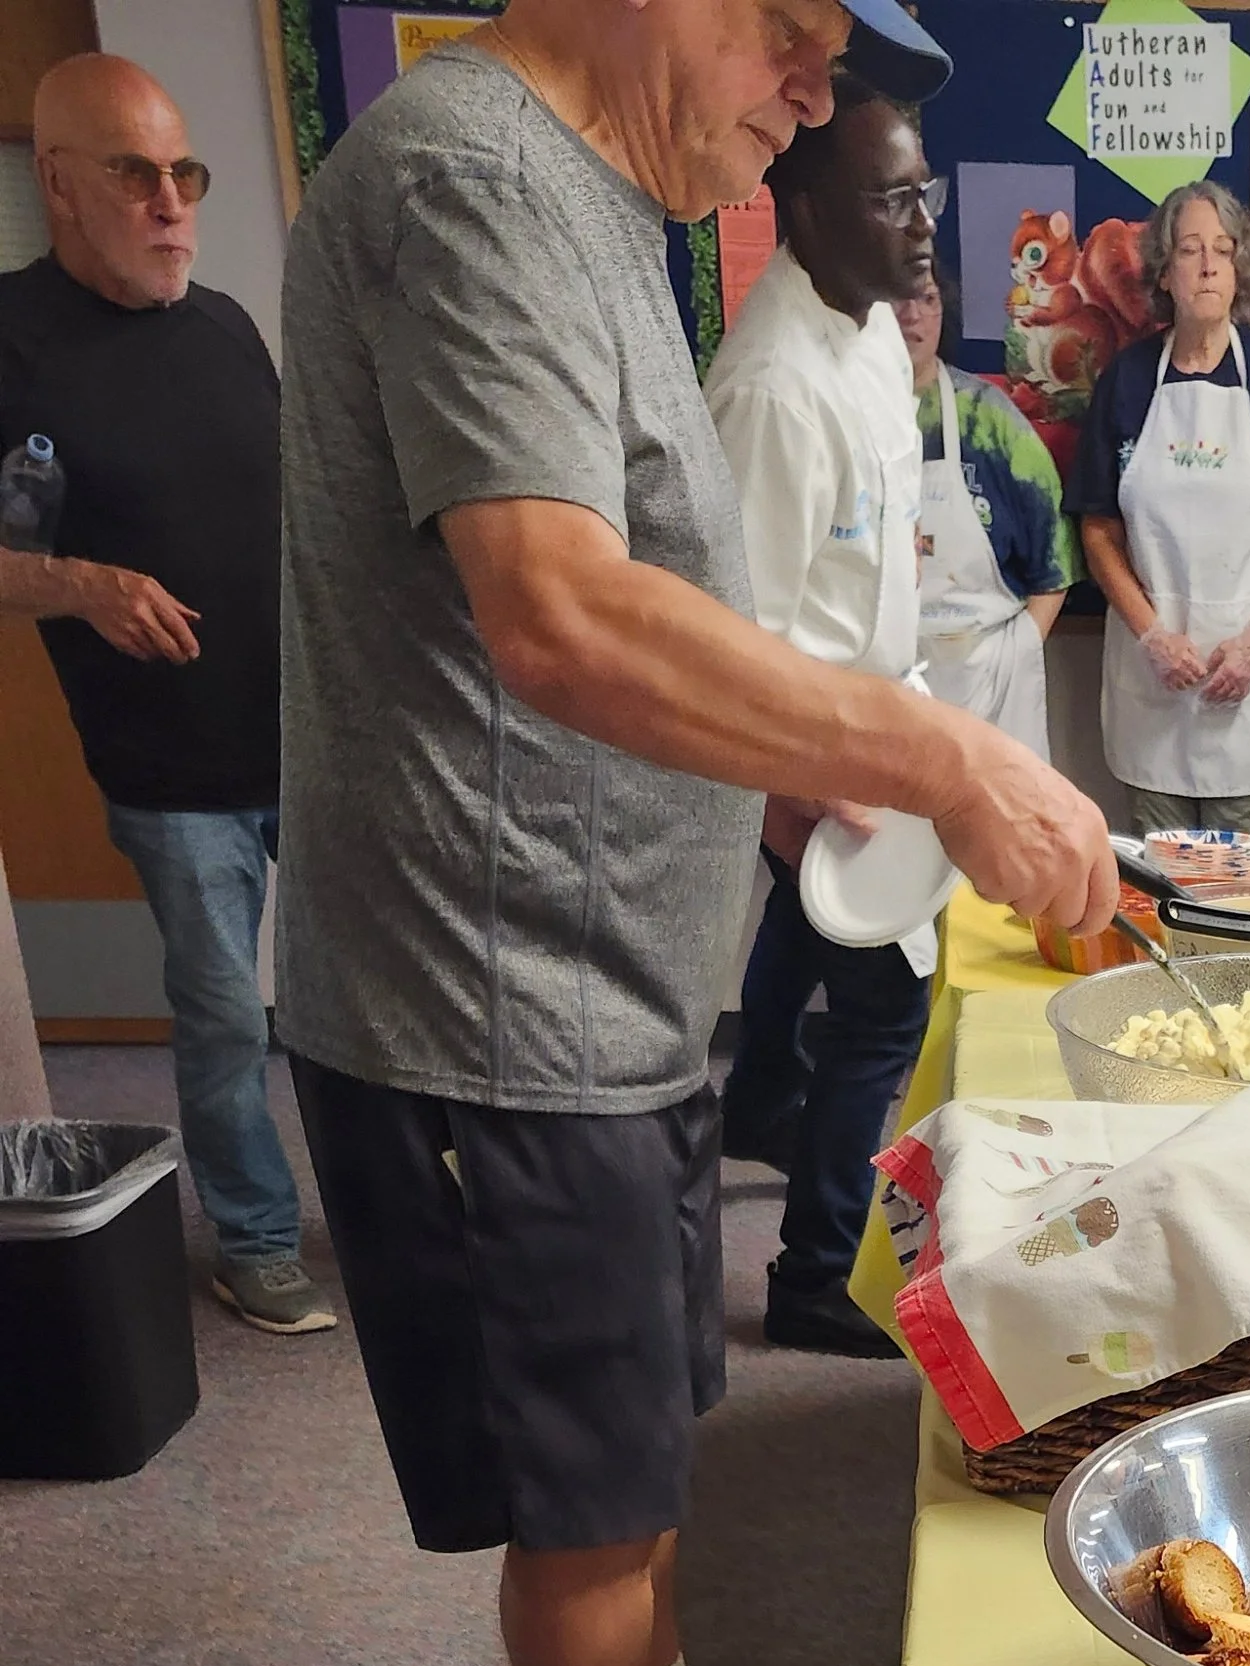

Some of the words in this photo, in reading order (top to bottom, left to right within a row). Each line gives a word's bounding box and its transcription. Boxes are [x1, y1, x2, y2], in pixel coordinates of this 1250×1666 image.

[1087, 27, 1207, 56] Lutheran
[1089, 60, 1173, 88] Adults
[1184, 68, 1205, 83] for
[1090, 92, 1128, 120] Fun
[1143, 102, 1166, 114] and
[1091, 122, 1227, 154] Fellowship
